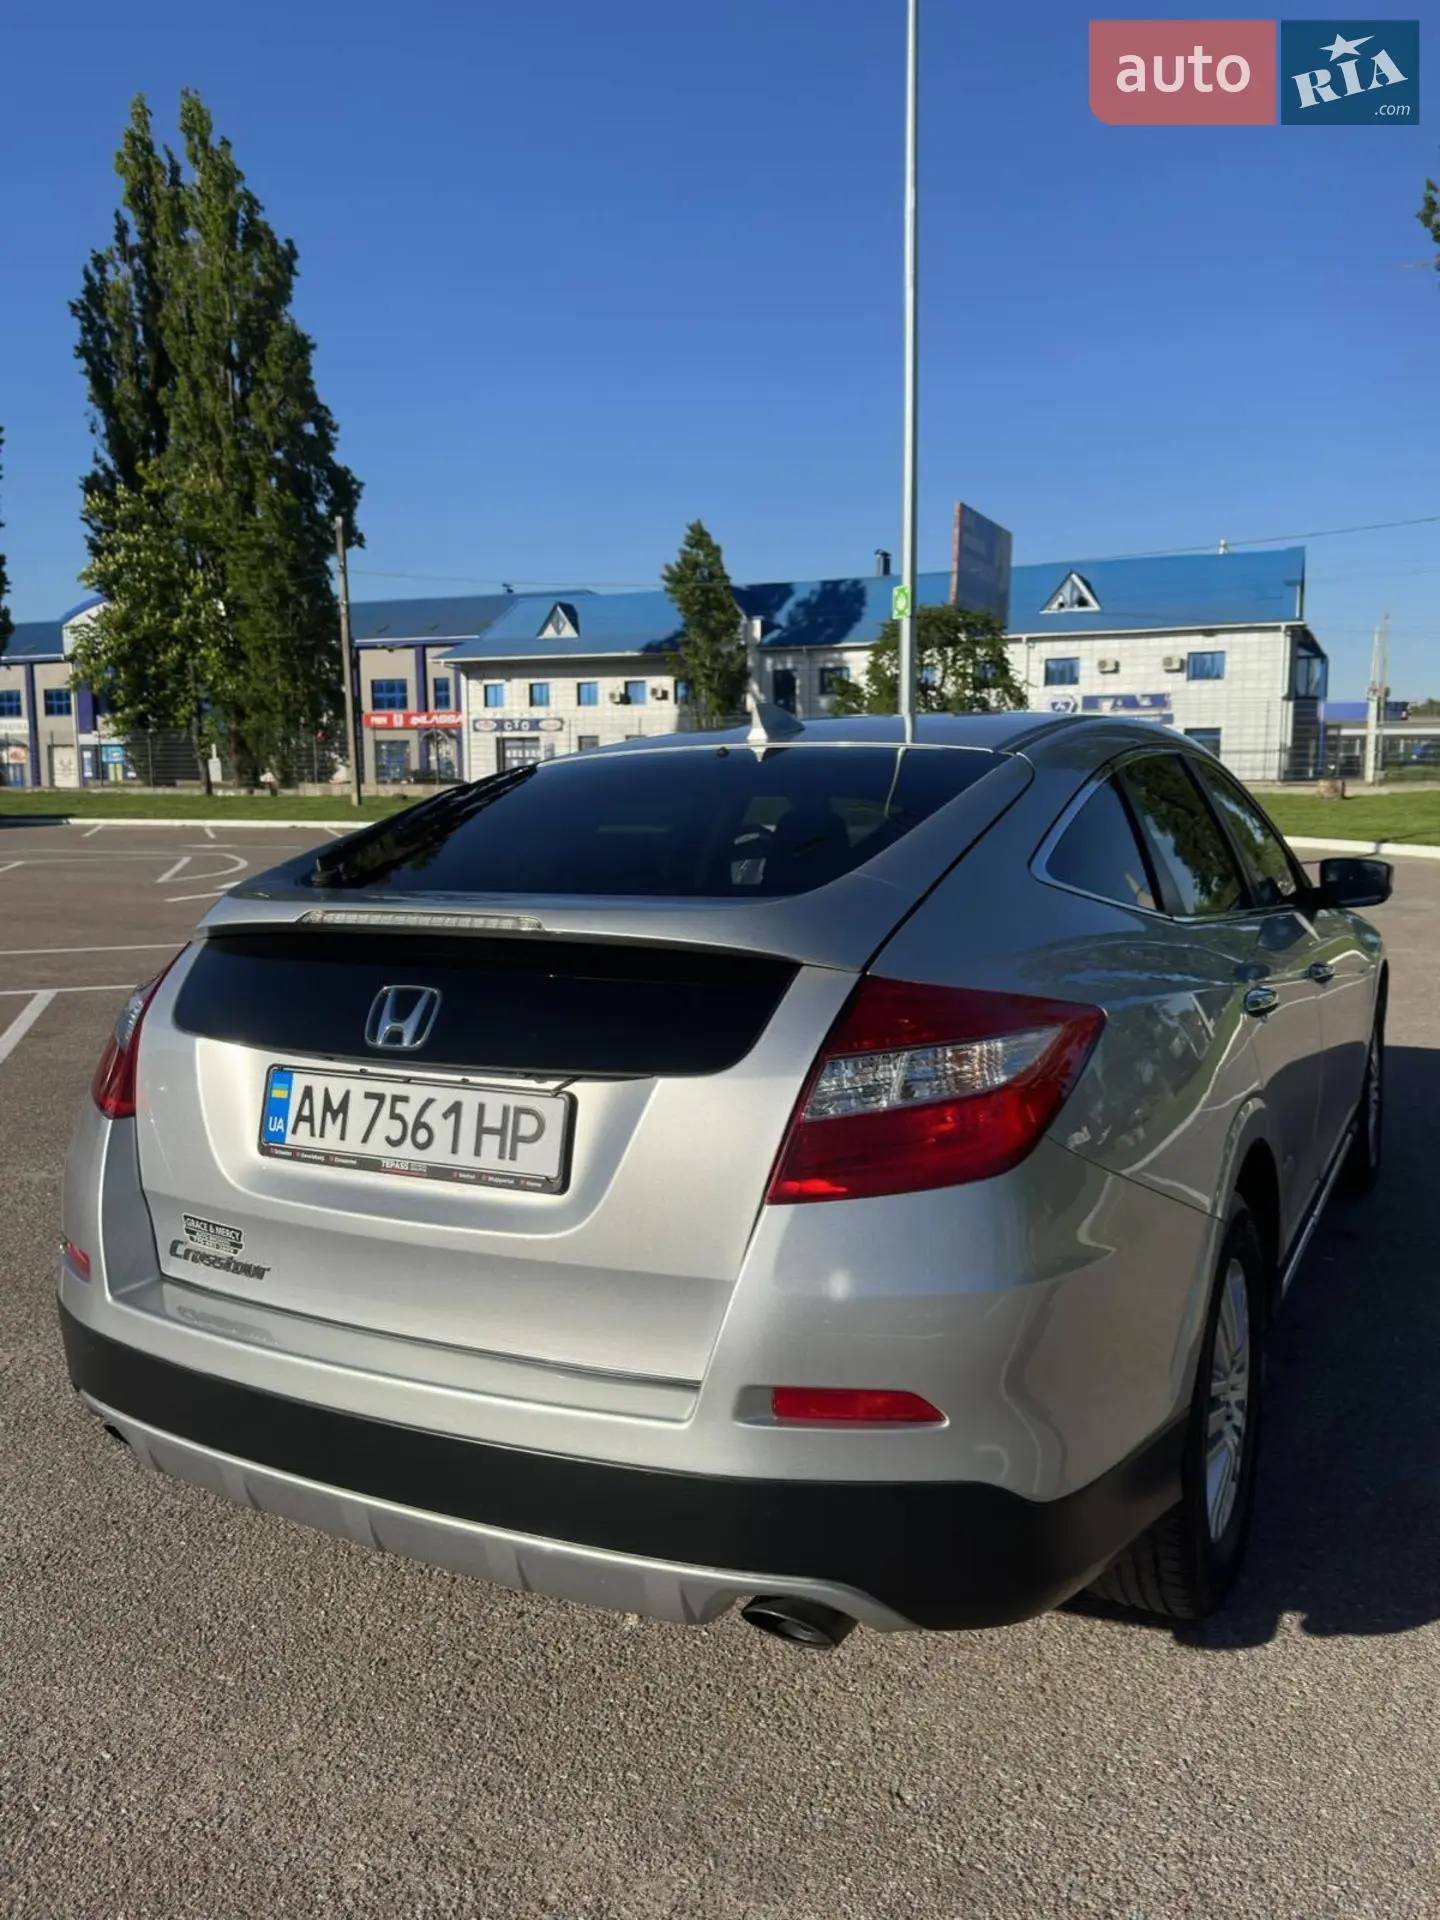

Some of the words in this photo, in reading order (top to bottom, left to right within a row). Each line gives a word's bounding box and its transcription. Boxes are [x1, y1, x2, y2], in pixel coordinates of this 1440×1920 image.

[269, 1116, 285, 1134] UA
[291, 1084, 351, 1141] AM
[361, 1091, 464, 1155] 7561
[473, 1102, 547, 1162] HP
